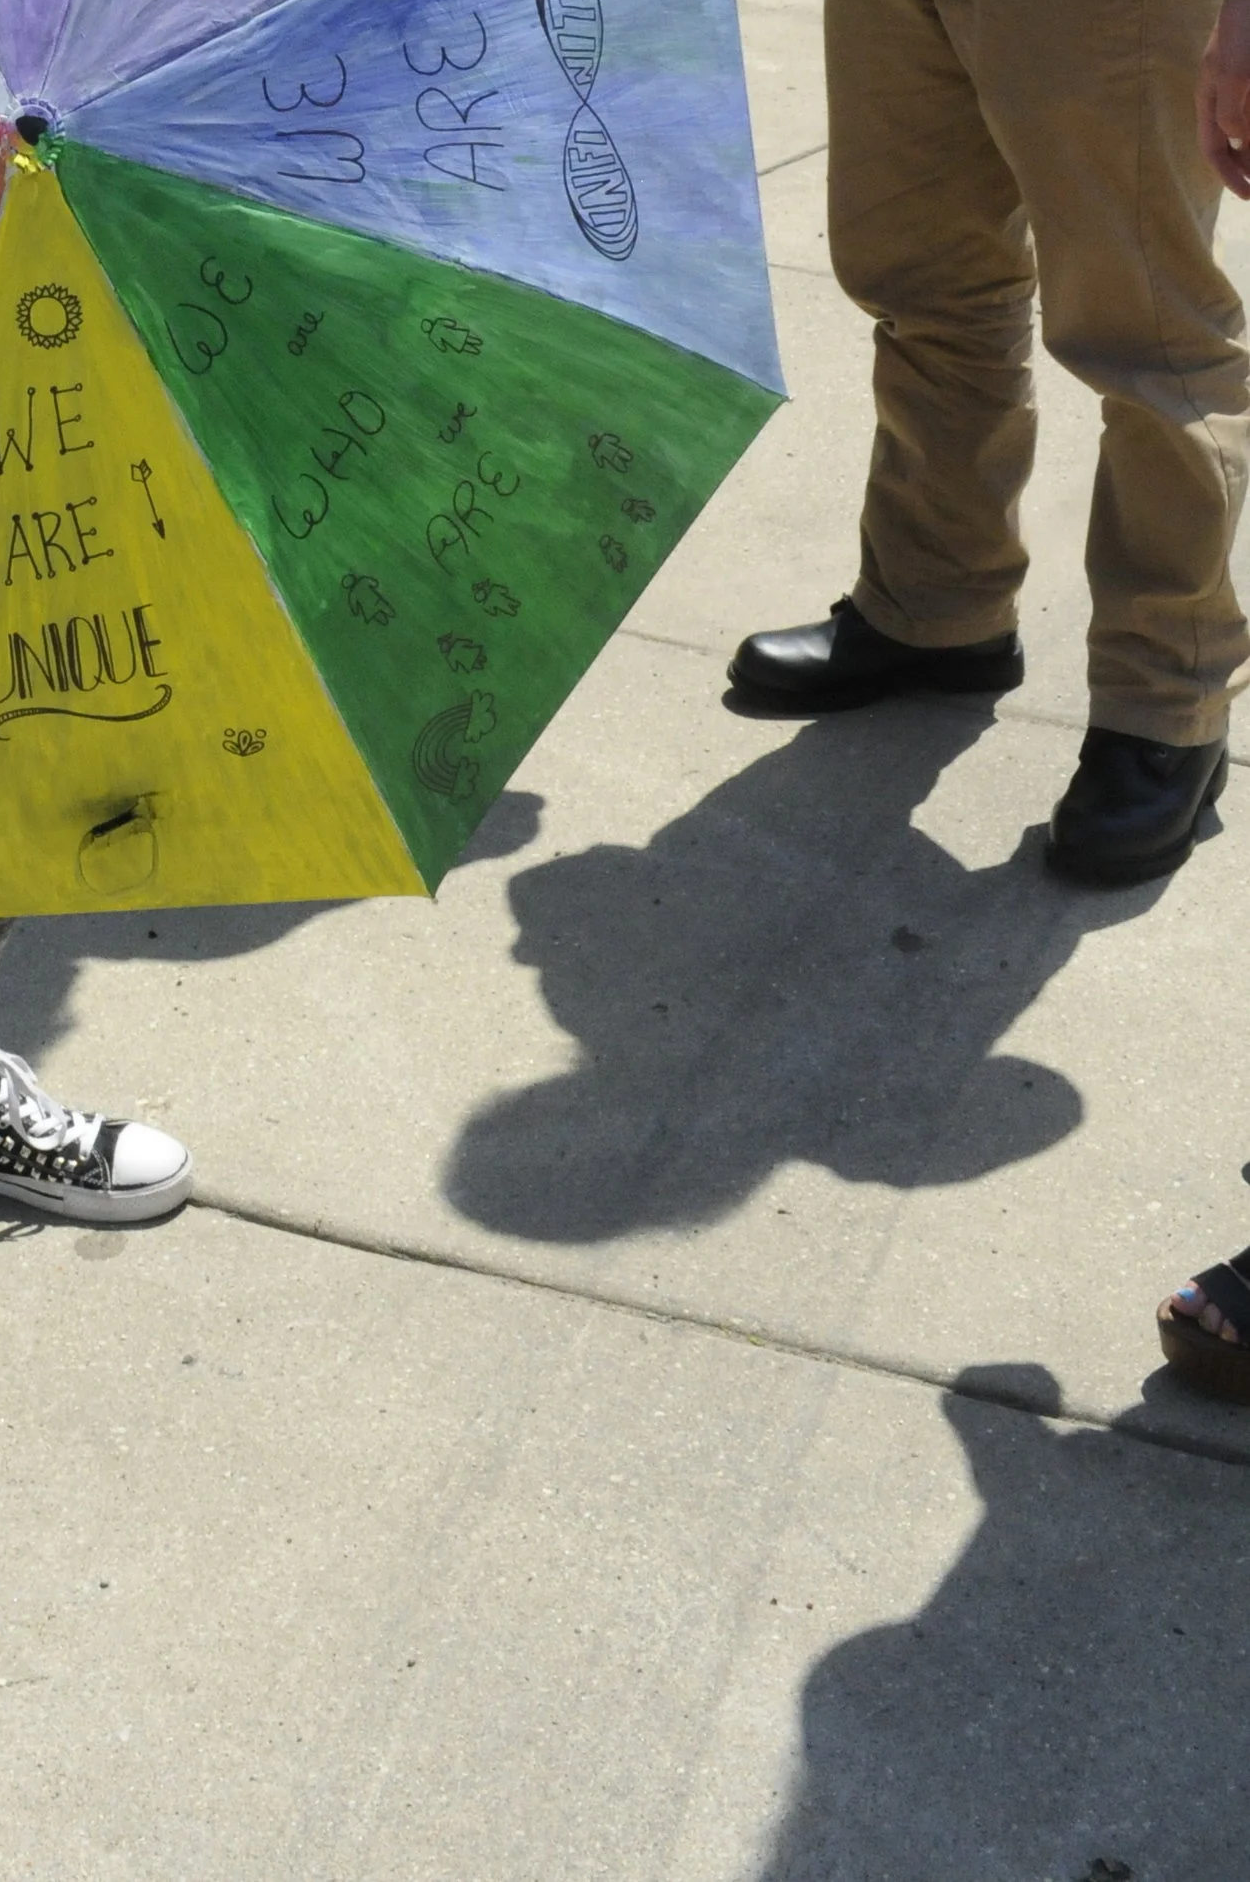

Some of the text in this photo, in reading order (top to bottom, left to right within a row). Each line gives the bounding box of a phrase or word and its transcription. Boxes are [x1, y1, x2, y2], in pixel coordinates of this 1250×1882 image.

[262, 54, 367, 183] WE
[403, 11, 505, 192] ARE
[164, 256, 253, 375] WE
[287, 310, 325, 357] are
[271, 390, 386, 540] WHO
[436, 402, 478, 444] we
[4, 496, 115, 586] ARE
[425, 450, 521, 577] ARE
